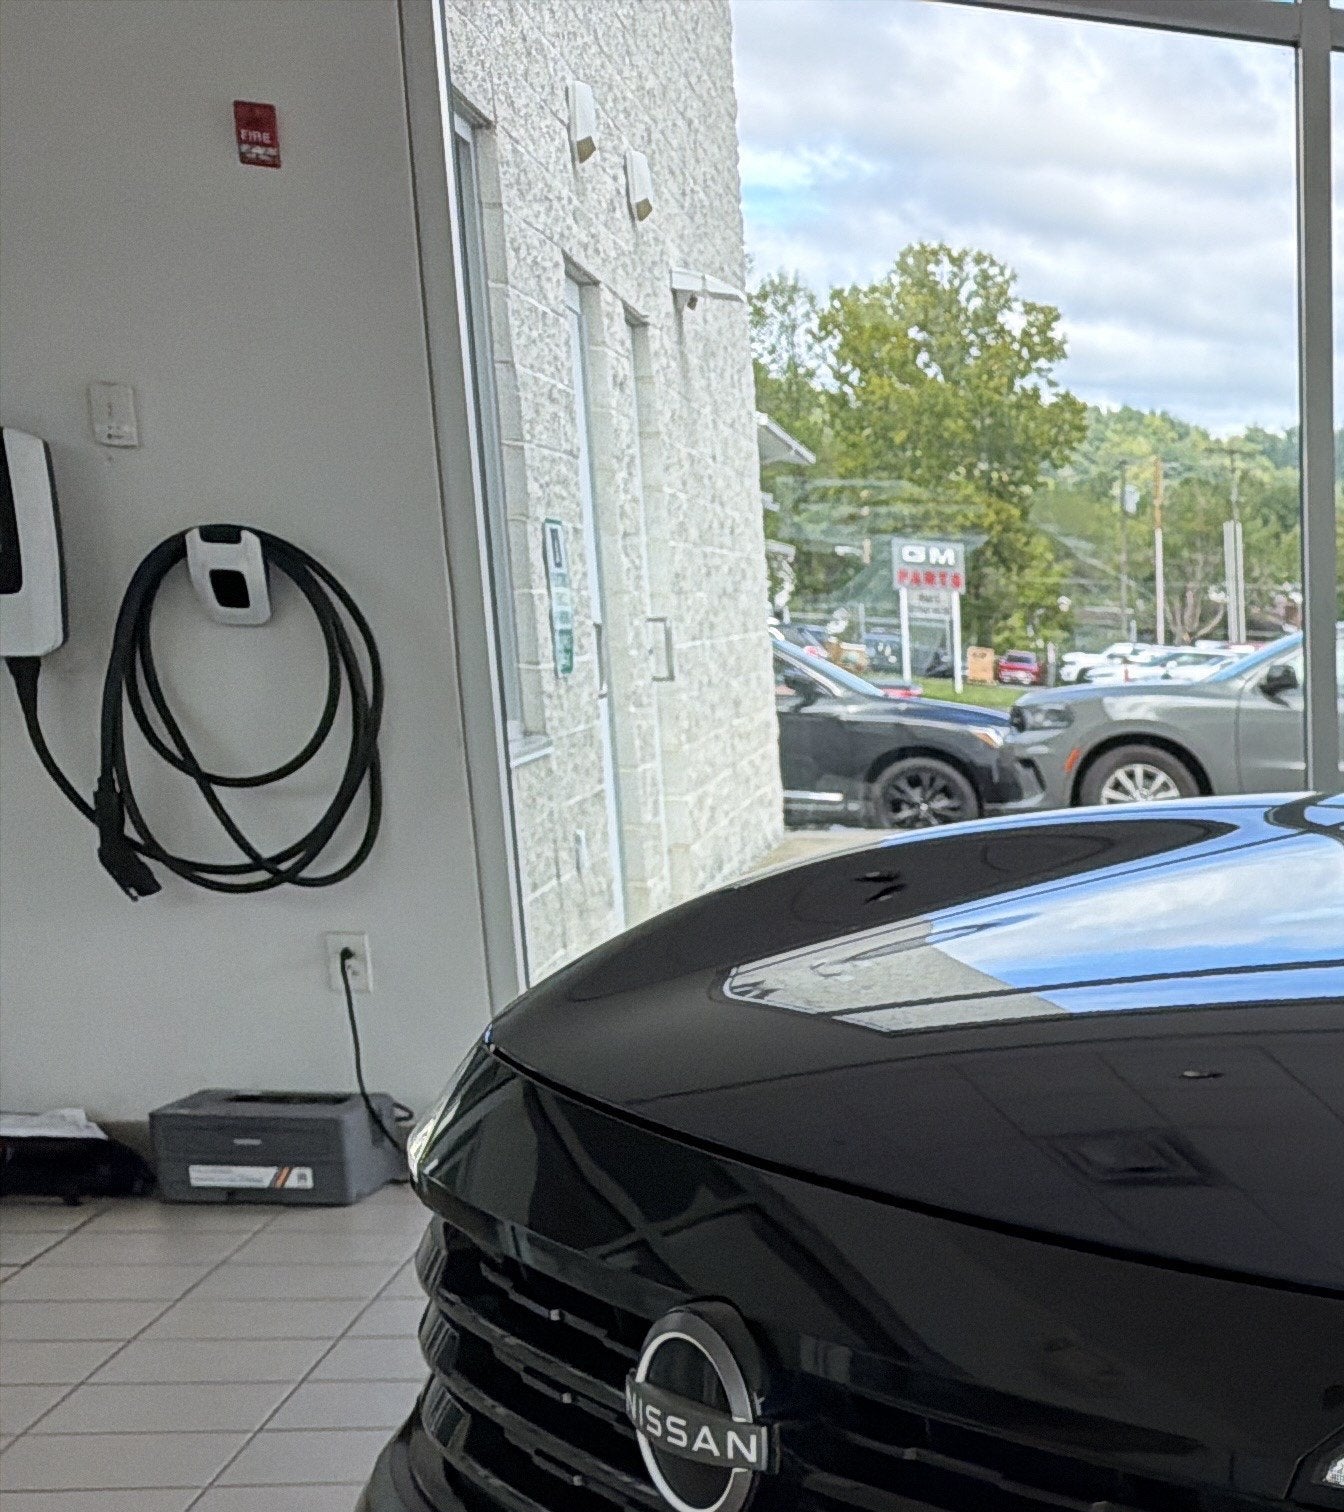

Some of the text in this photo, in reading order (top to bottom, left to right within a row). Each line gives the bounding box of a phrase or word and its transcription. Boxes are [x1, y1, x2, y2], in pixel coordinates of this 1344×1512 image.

[901, 545, 955, 566] GM
[897, 568, 963, 589] PARTS
[625, 1383, 757, 1463] NISSAN
